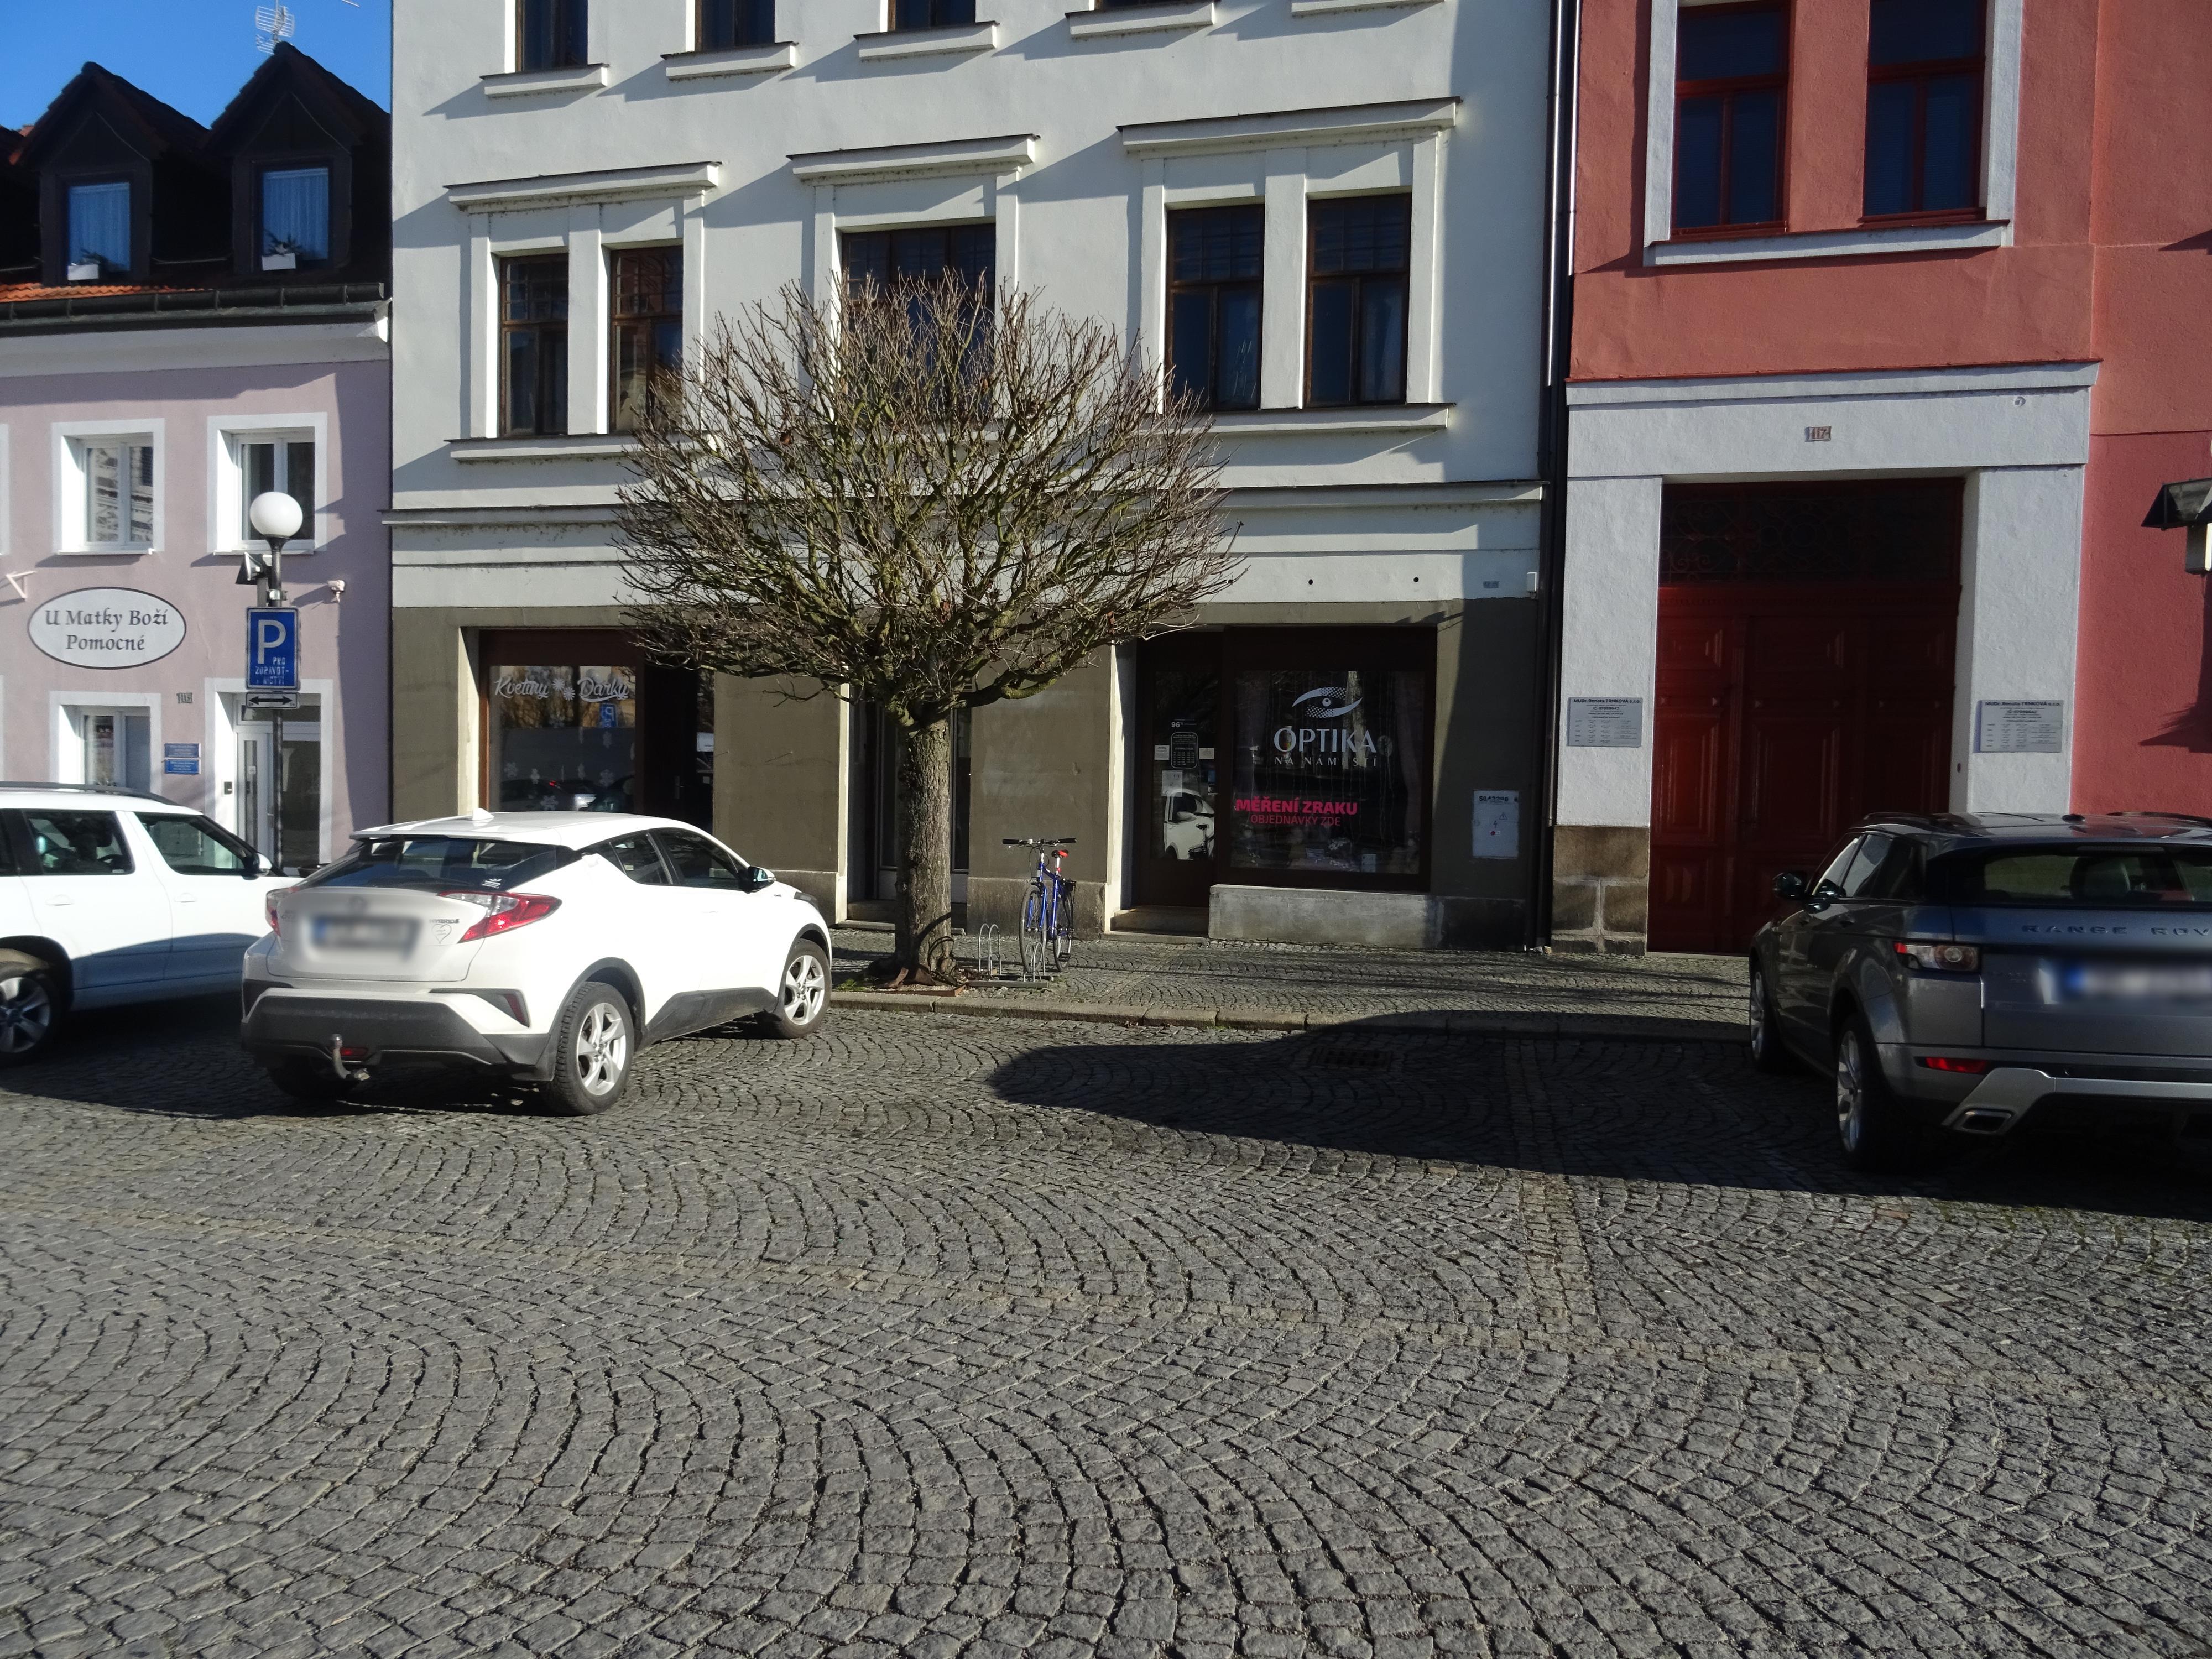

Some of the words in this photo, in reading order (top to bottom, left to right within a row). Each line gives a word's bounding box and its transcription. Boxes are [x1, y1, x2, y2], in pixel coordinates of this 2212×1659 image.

[45, 609, 61, 625] U
[66, 607, 122, 632] Matky
[128, 609, 168, 625] Boží
[66, 634, 145, 650] Pomocné
[258, 619, 286, 664] P
[273, 656, 286, 665] PRO
[1274, 728, 1376, 753] OPTIKA
[1275, 756, 1294, 765] NA
[1235, 796, 1300, 813] MĚŘENÍ
[1302, 801, 1358, 815] ZRAKU
[1250, 813, 1318, 825] OBJEDNÁVKY
[1321, 816, 1341, 826] ZDE
[2021, 925, 2129, 935] RANGE
